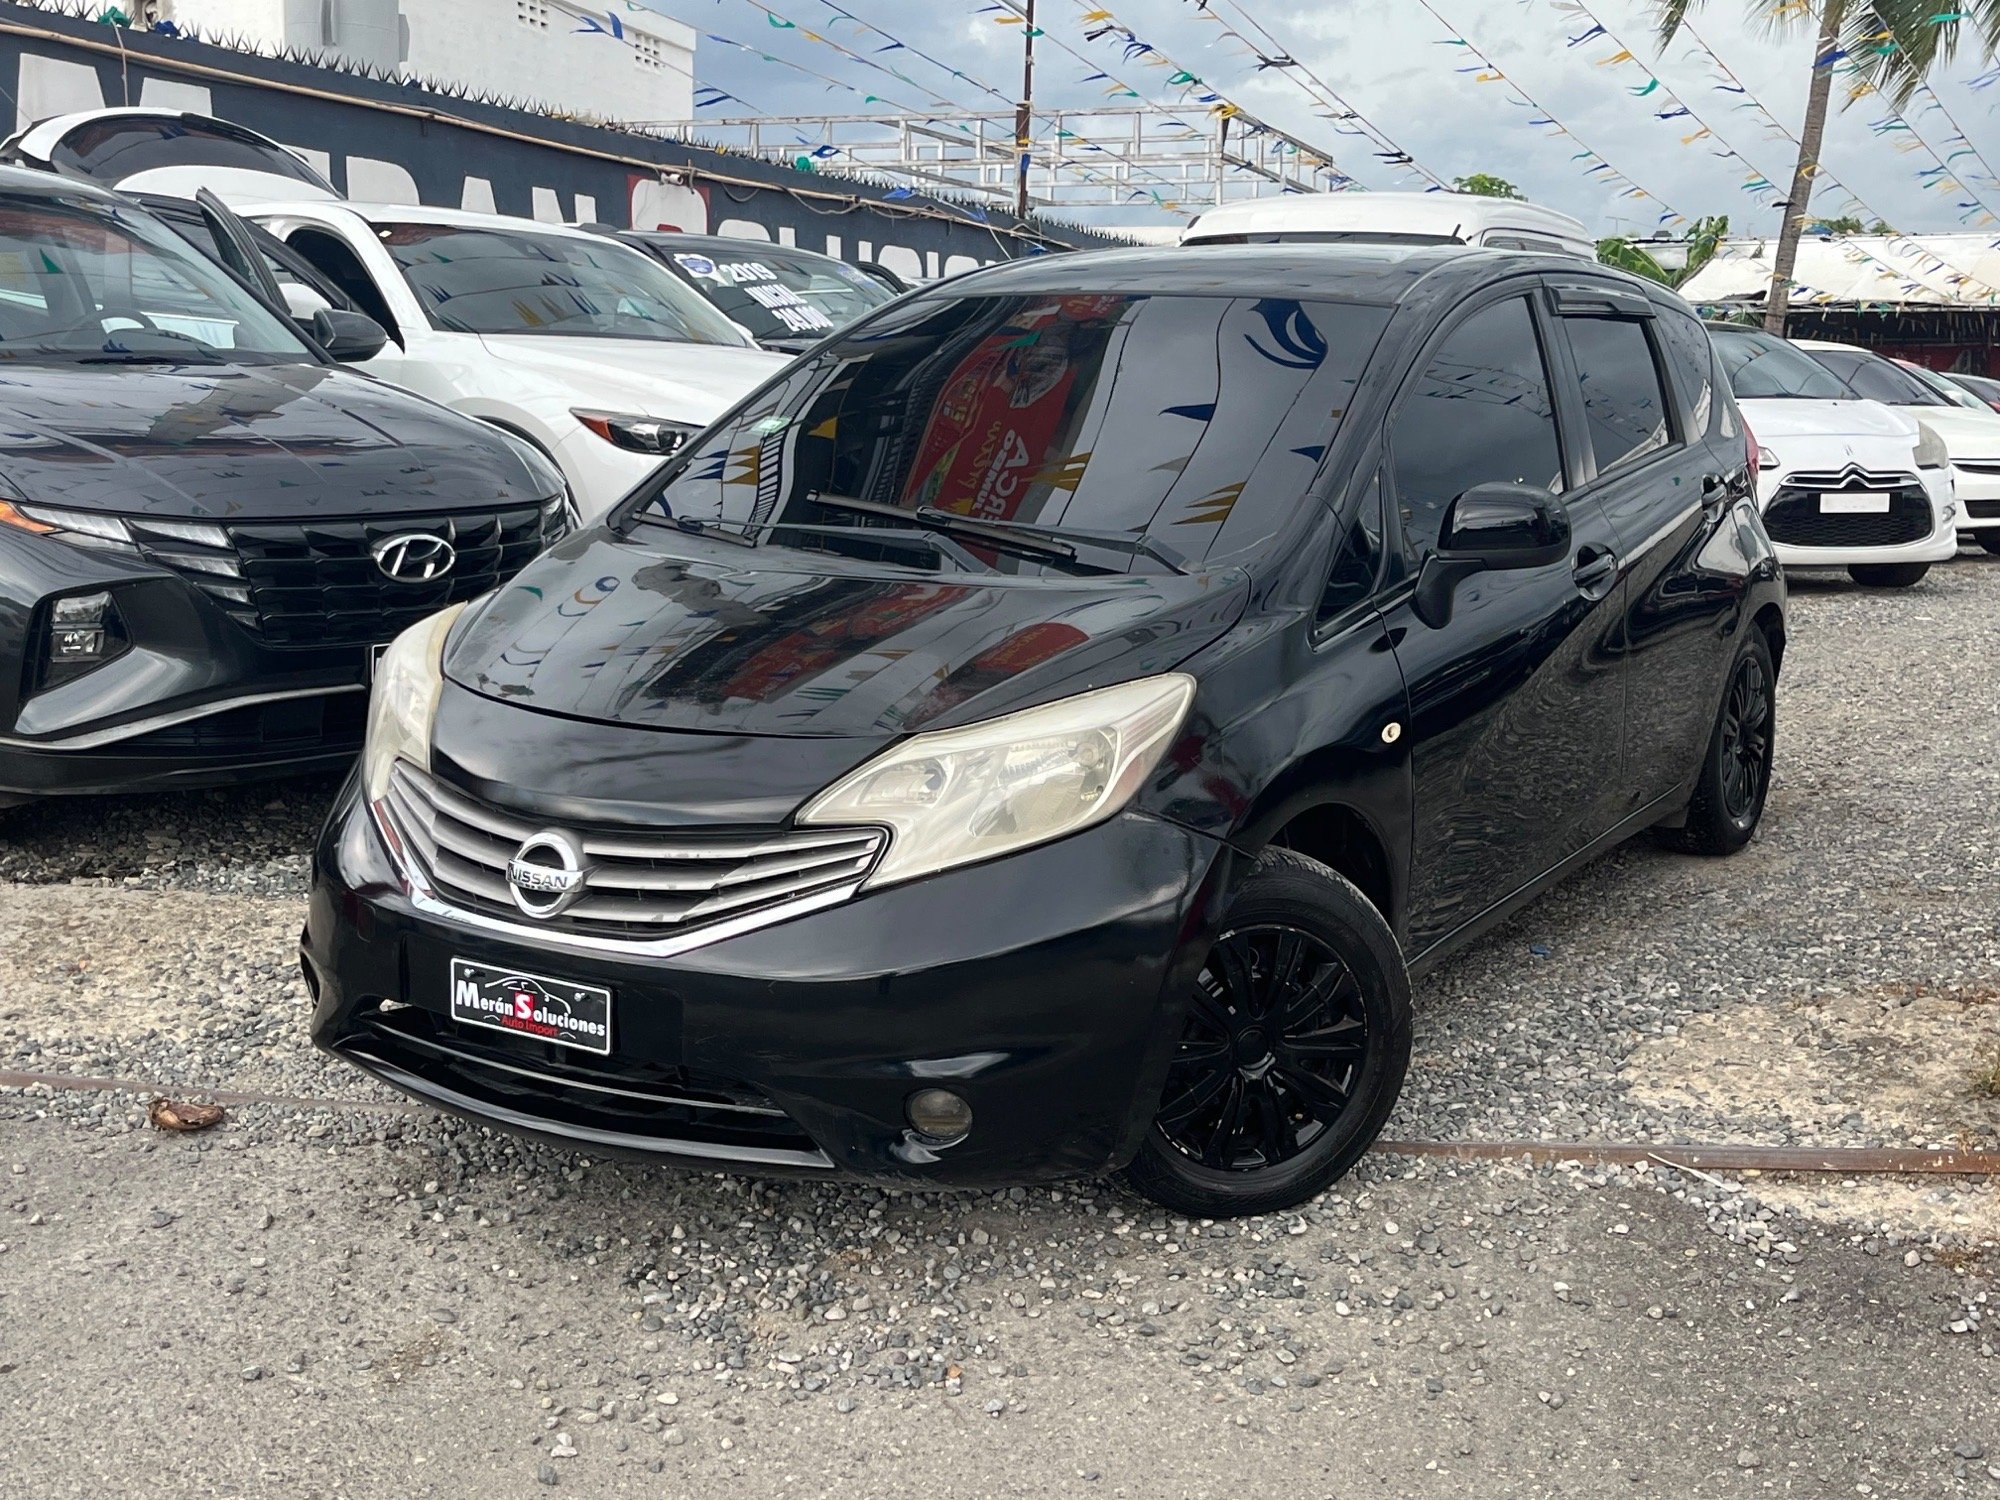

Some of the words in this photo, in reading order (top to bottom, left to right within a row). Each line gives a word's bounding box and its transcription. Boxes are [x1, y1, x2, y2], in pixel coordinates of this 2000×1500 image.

[718, 262, 778, 282] 2019
[744, 284, 808, 309] INICIAL
[507, 861, 568, 888] NISSAN
[456, 979, 514, 1016] Merán
[515, 993, 606, 1036] Soluciones
[501, 1016, 525, 1029] Auto
[526, 1021, 560, 1037] Import
